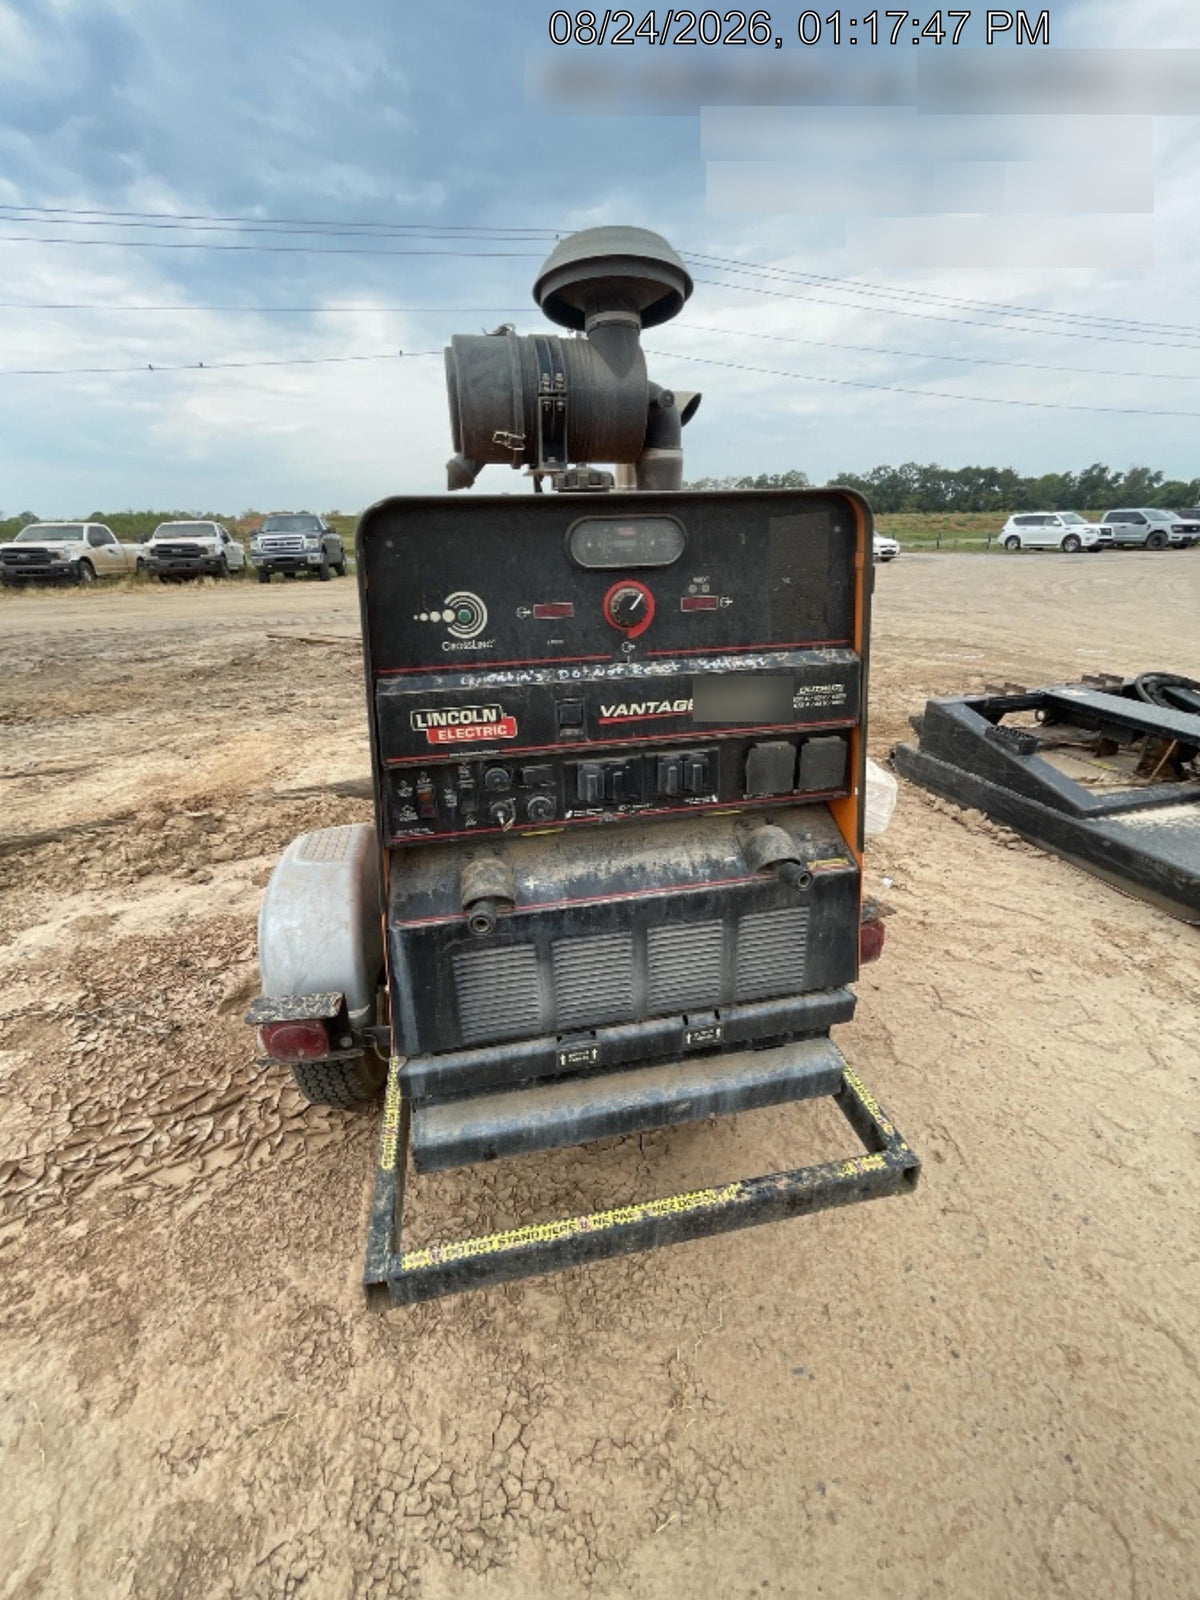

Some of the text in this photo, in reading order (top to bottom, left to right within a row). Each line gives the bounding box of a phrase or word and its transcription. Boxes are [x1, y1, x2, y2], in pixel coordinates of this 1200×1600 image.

[415, 708, 497, 728] LINCOLN
[438, 725, 507, 740] ELECTRIC
[468, 1239, 495, 1252] NOT
[499, 1230, 540, 1246] STAND
